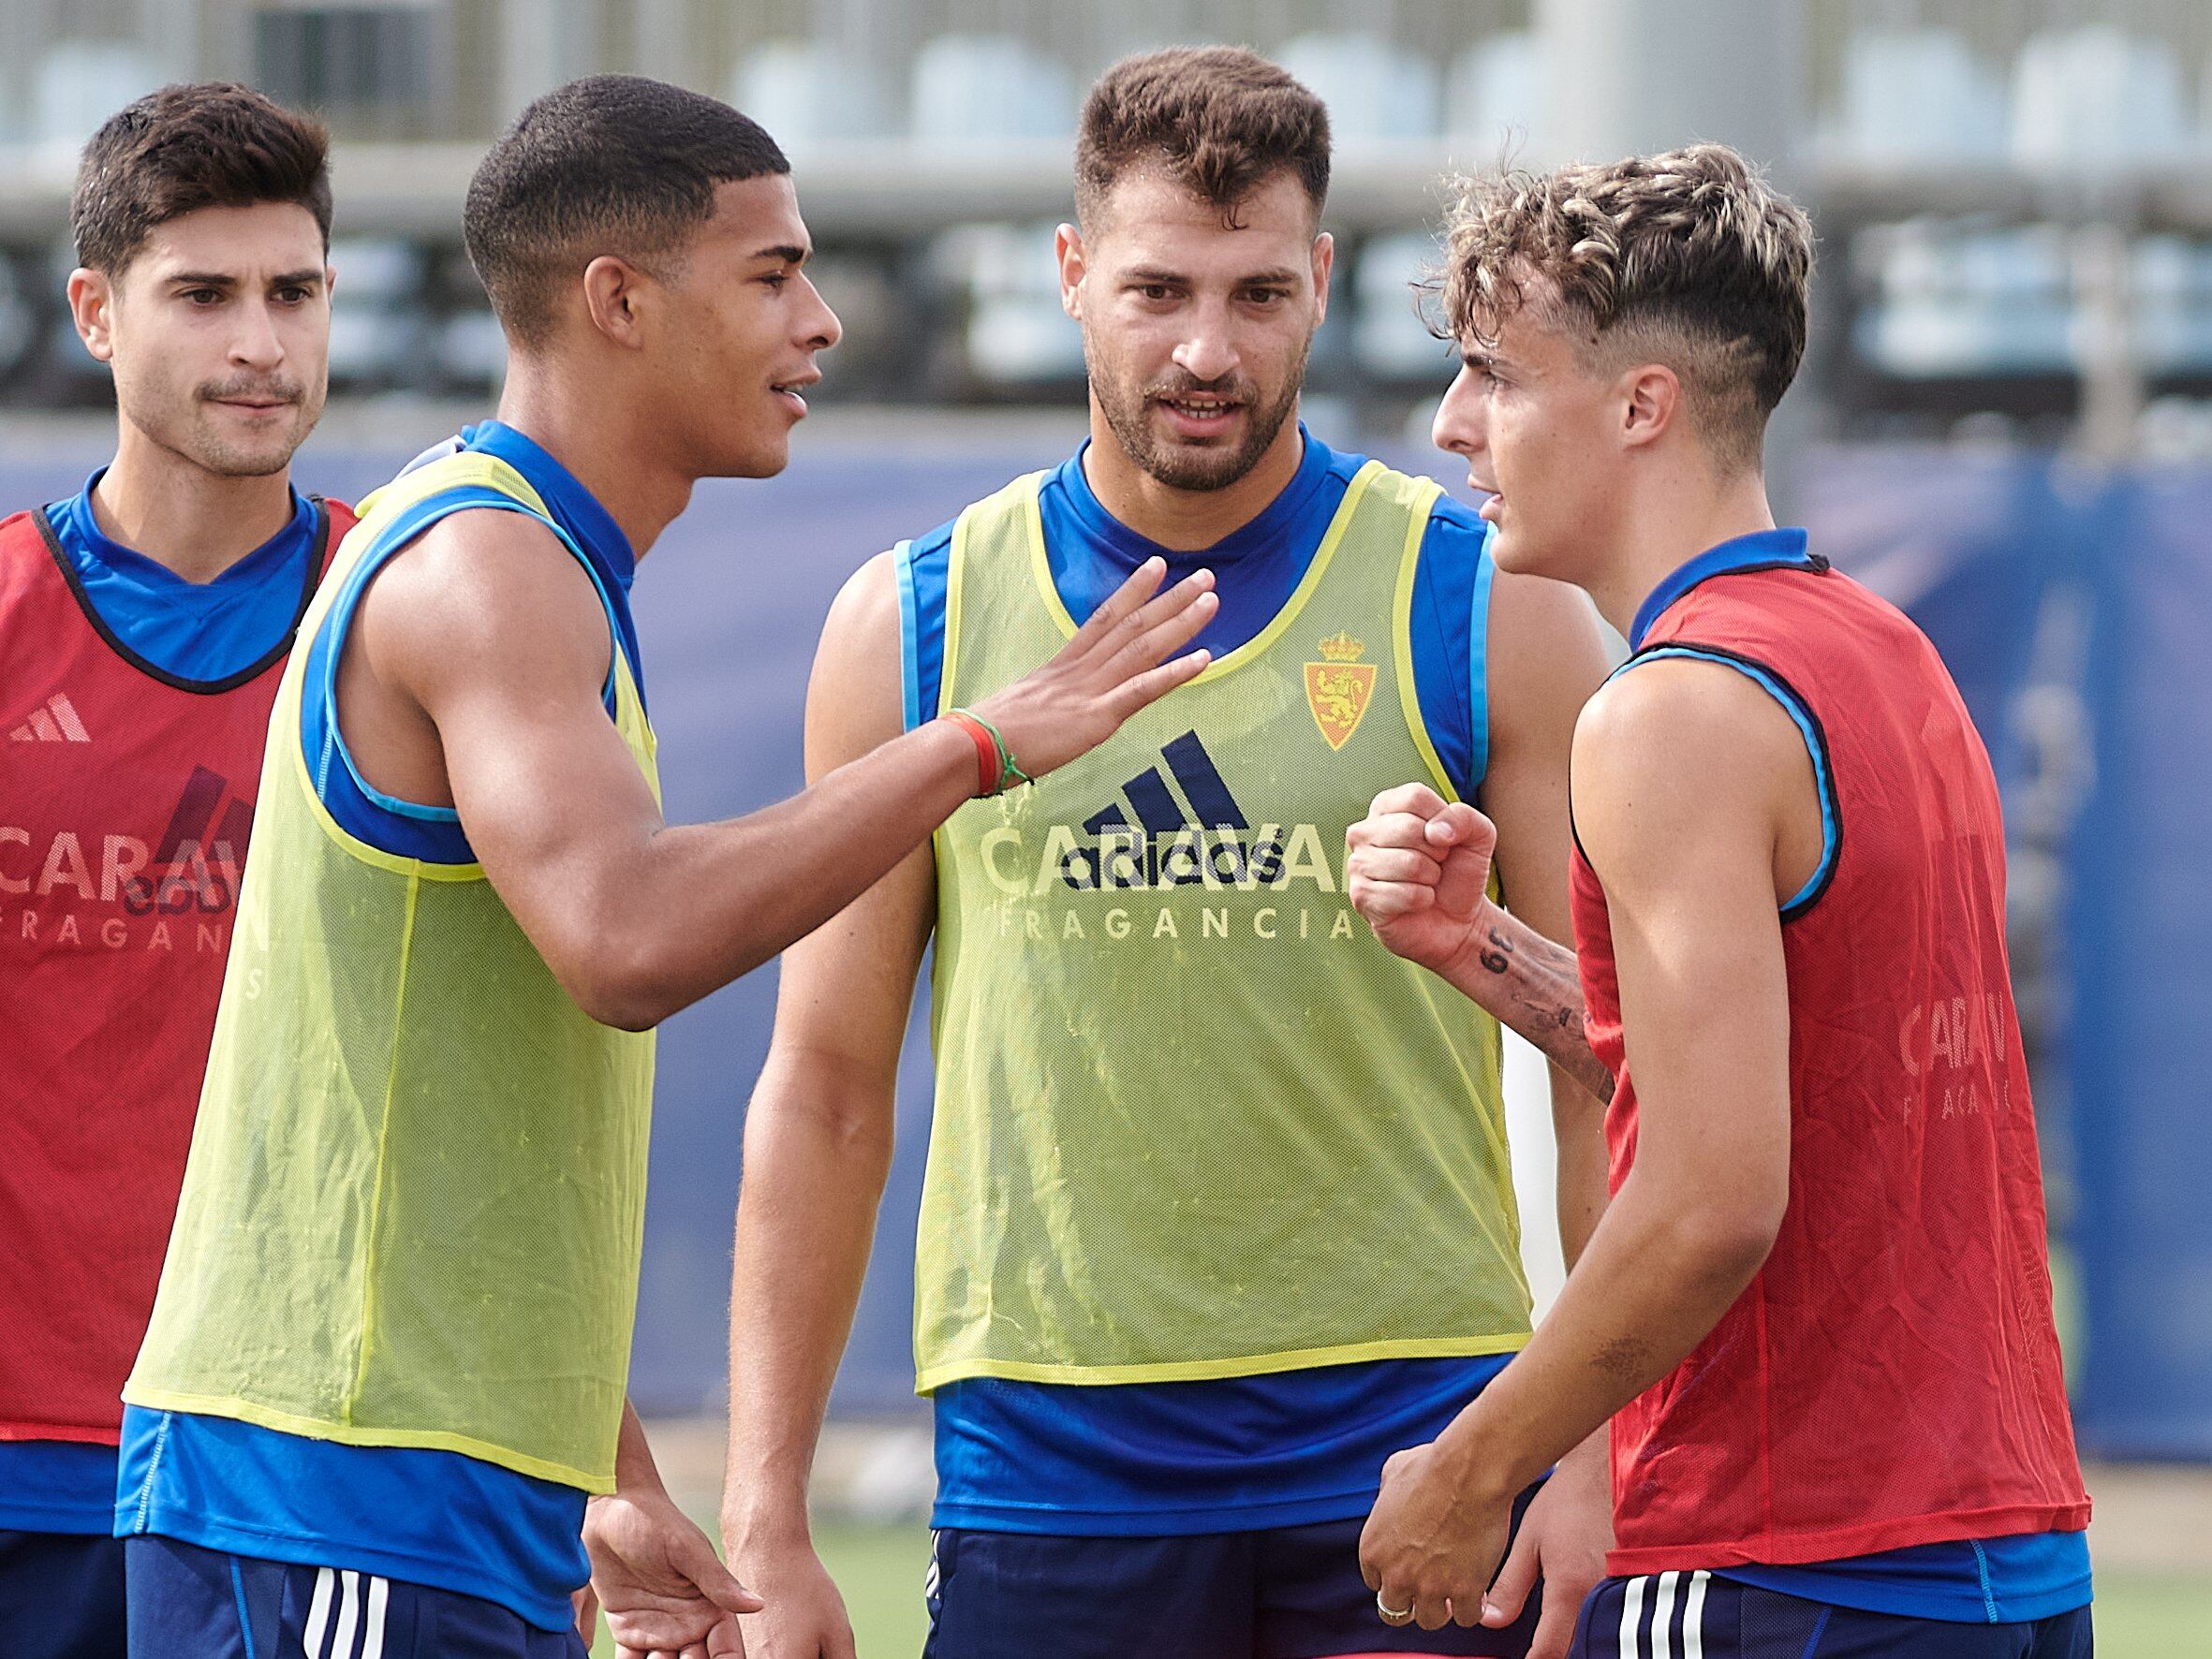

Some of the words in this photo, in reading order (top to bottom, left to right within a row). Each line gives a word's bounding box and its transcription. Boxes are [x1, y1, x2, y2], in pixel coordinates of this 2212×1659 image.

[981, 823, 1350, 895] CARAVA
[1061, 826, 1287, 890] adidas
[0, 904, 222, 954] RAGAN
[999, 906, 1355, 940] FRAGANCIA
